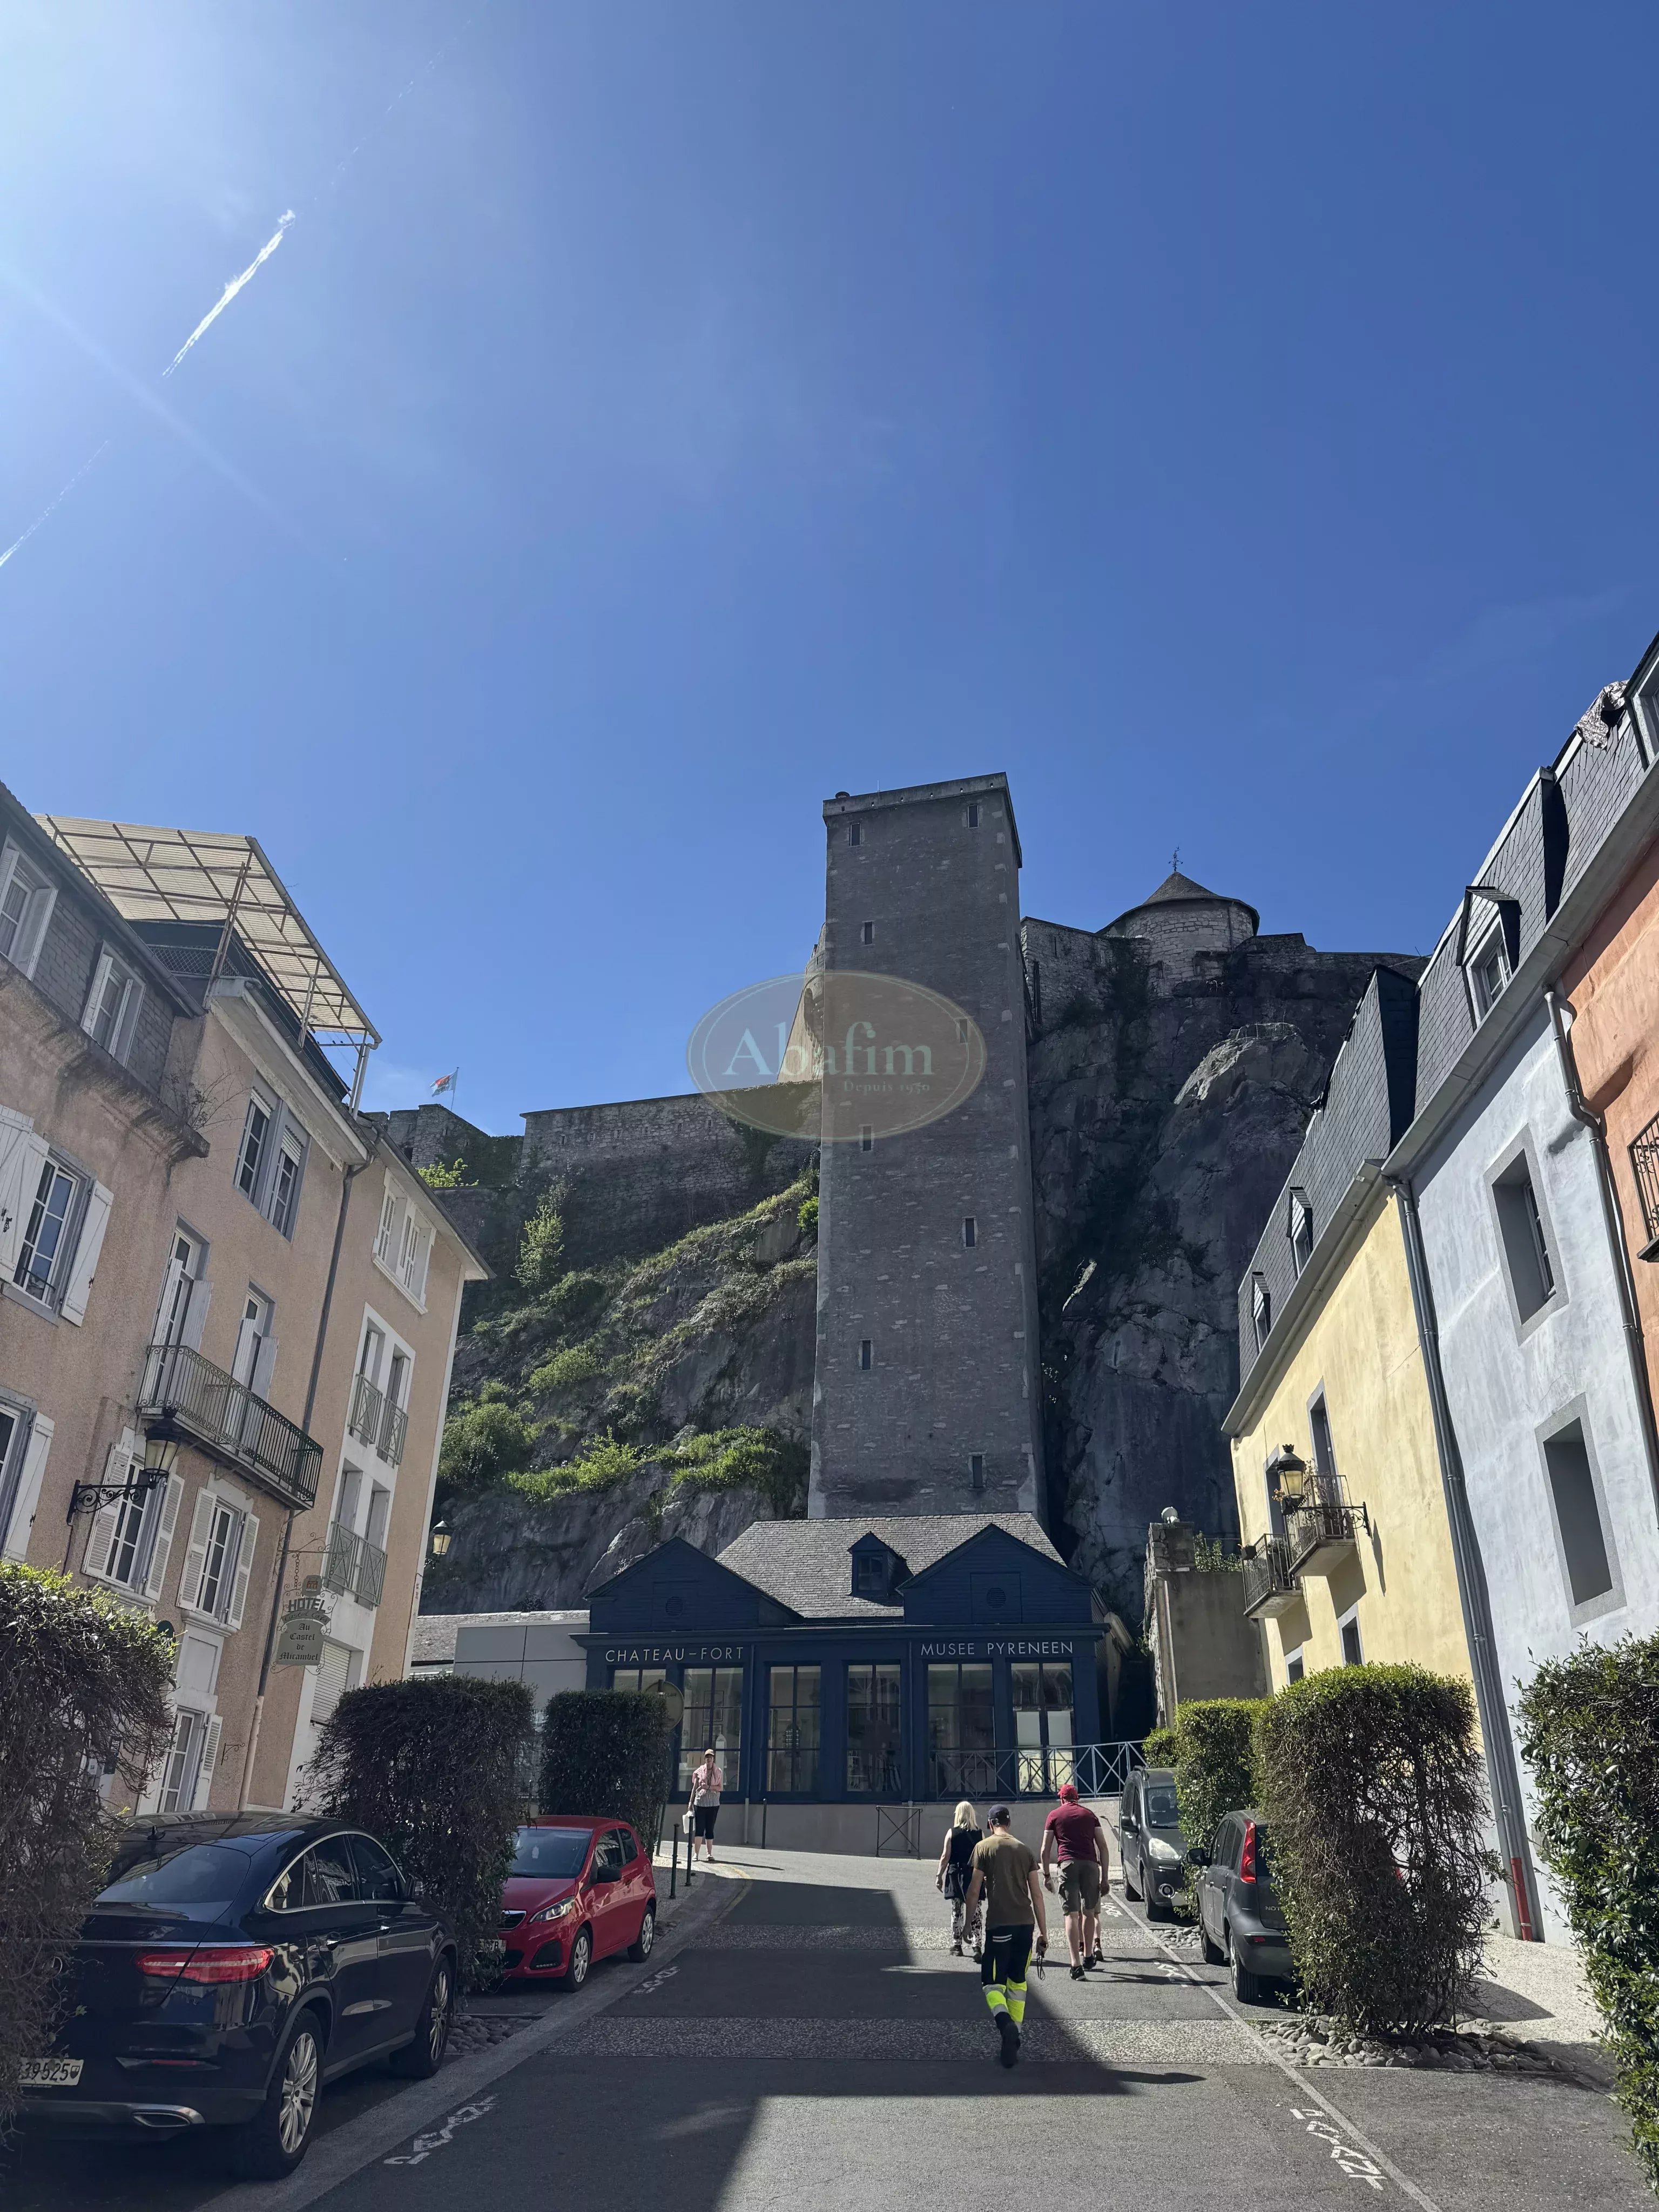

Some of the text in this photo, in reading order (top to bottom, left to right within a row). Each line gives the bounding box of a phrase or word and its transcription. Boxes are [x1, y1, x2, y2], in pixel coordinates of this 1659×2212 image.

[288, 1597, 326, 1613] HOTEL
[921, 1641, 1073, 1656] MUSEE PYRENEEN
[279, 1653, 319, 1661] Mirambel
